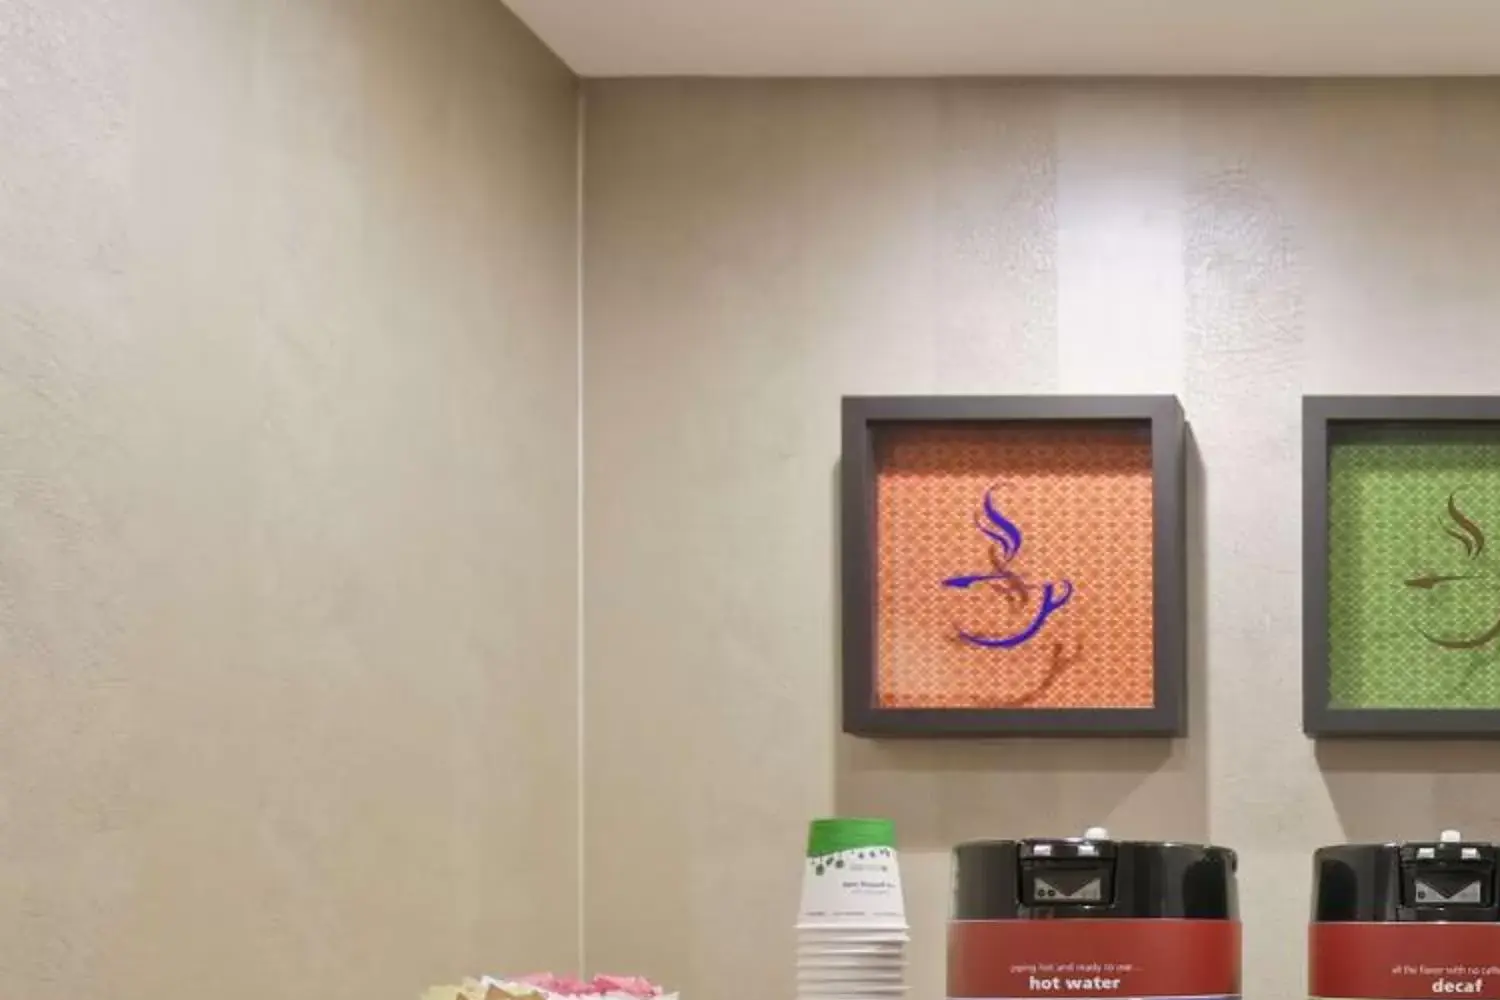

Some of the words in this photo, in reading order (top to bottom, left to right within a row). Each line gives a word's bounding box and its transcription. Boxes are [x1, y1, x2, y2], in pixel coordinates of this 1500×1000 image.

[1028, 976, 1061, 991] hot
[1065, 976, 1121, 991] water
[1431, 977, 1484, 993] decaf
